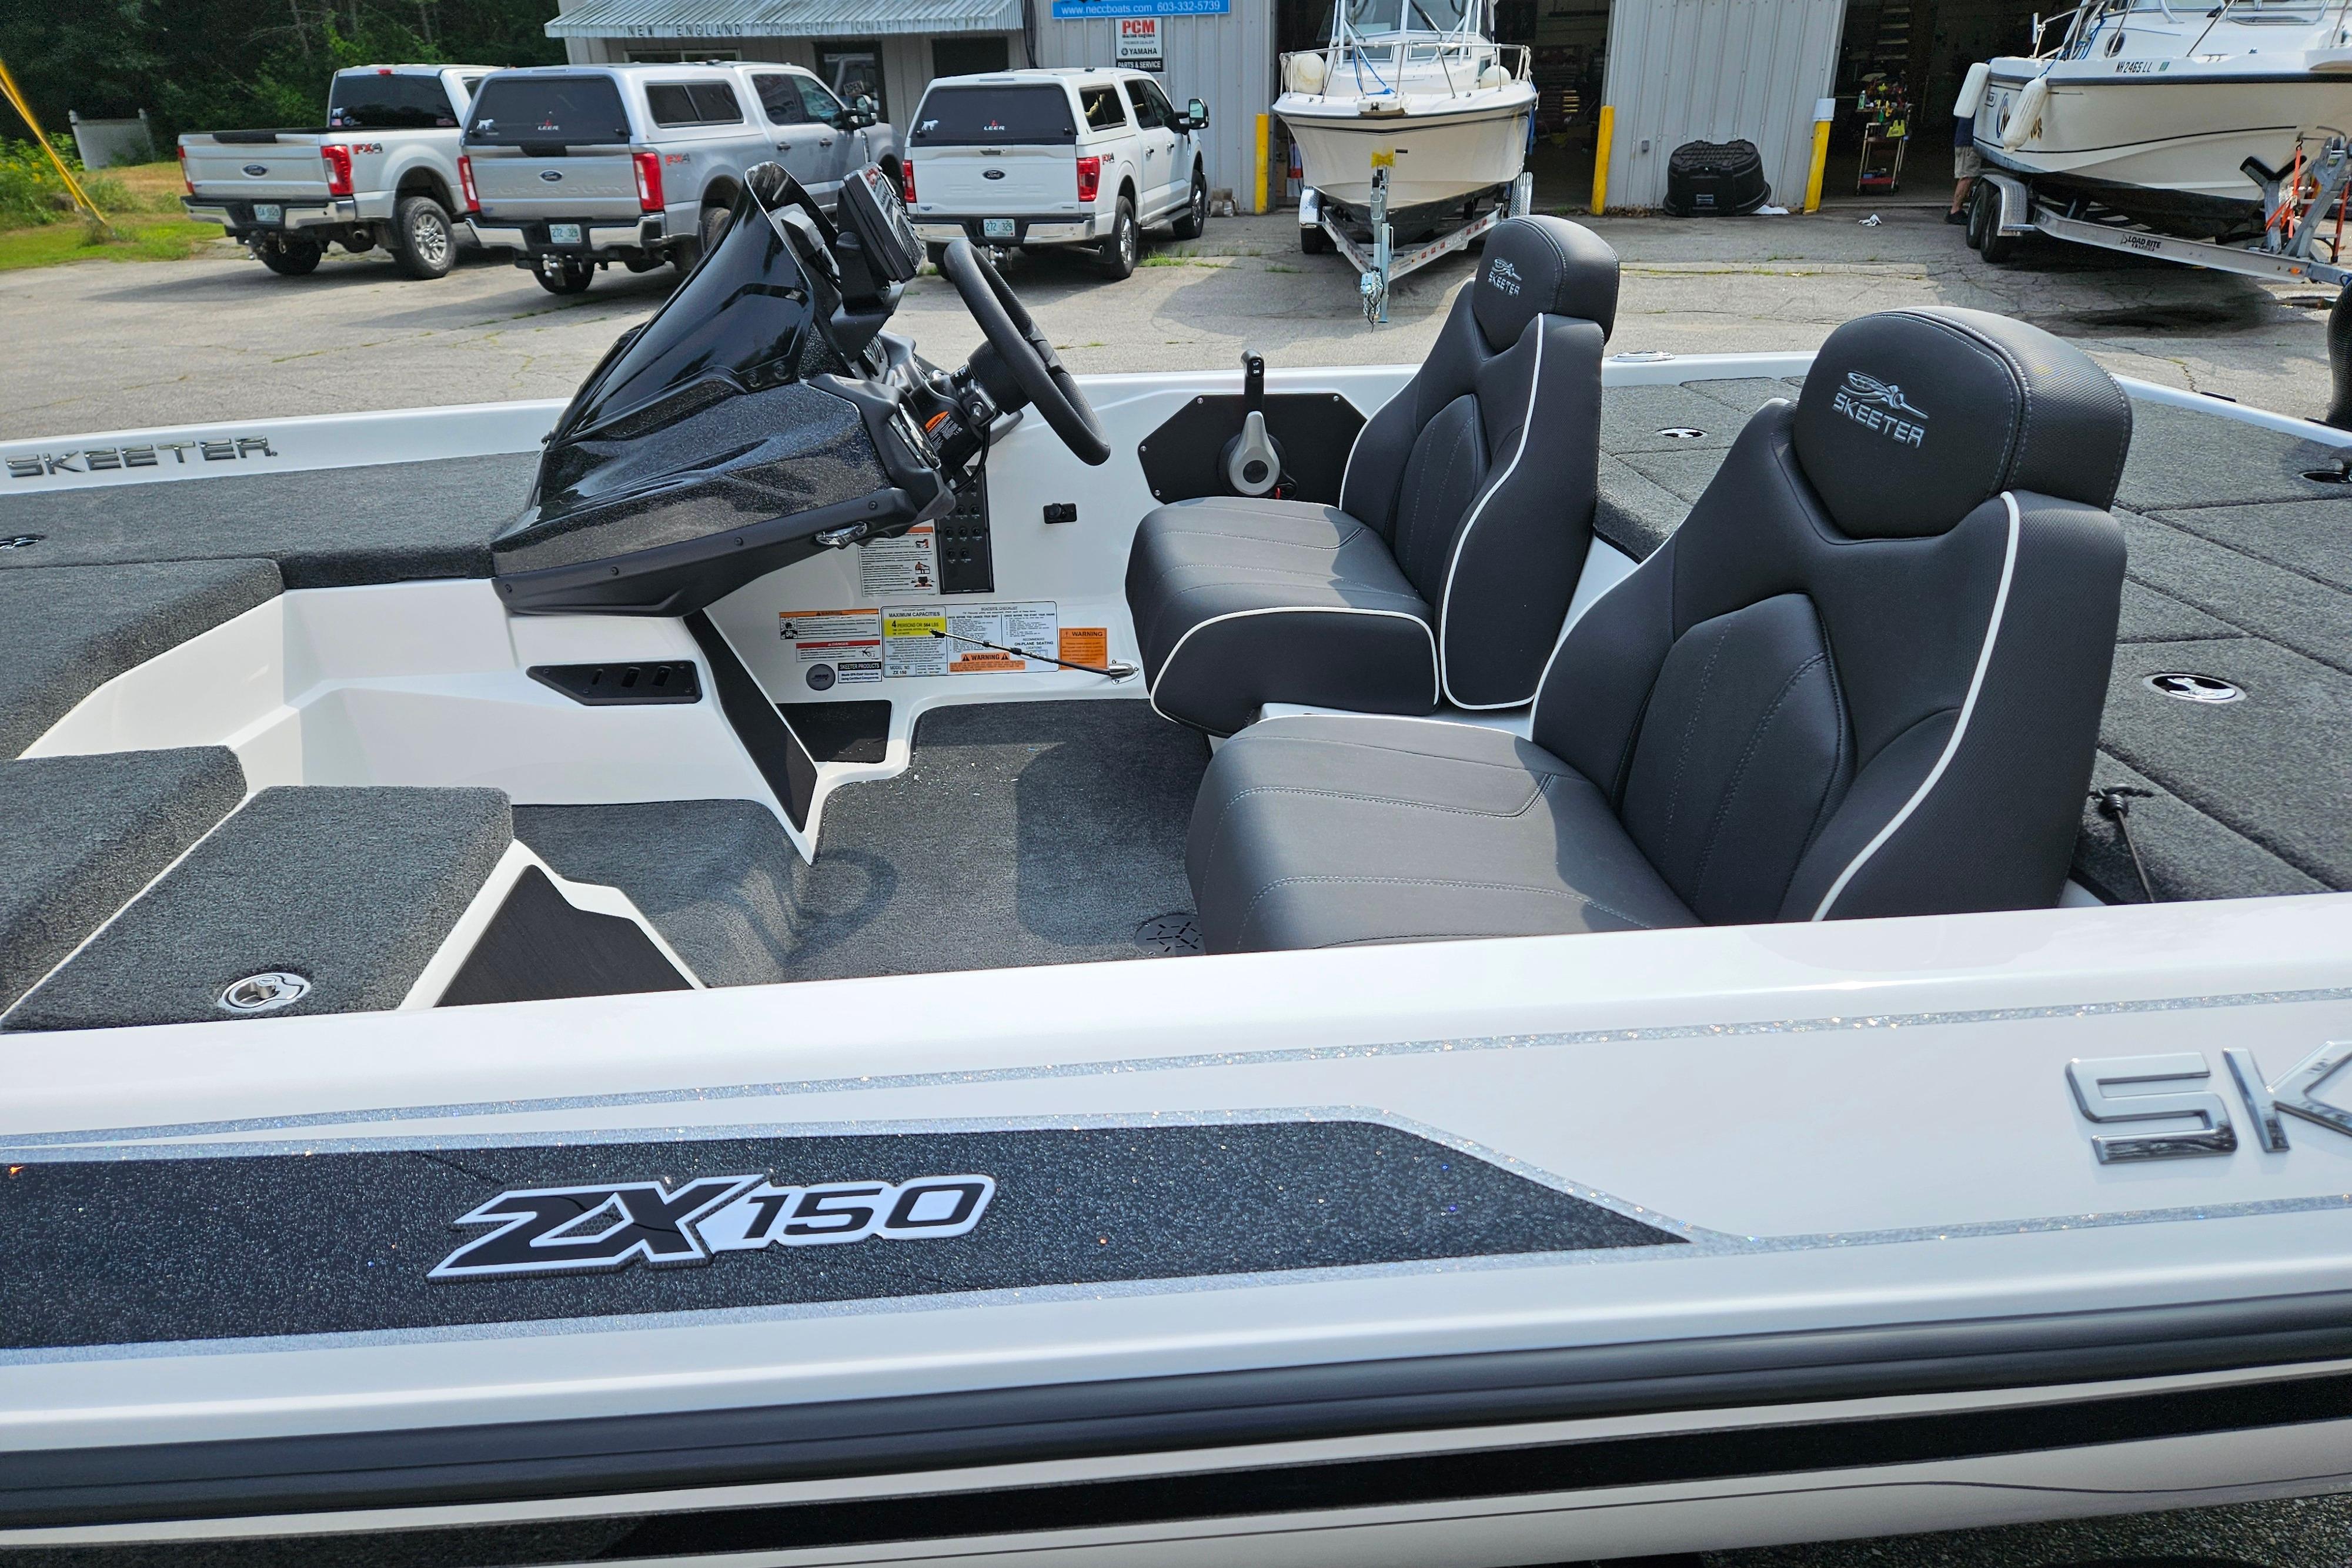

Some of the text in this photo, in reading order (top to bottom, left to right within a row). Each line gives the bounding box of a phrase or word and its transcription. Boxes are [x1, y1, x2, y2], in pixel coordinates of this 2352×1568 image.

[1061, 1, 1220, 15] www.neccboats.com 603-332-5739
[627, 25, 653, 36] NEW
[677, 24, 741, 36] ENGLAND
[1122, 19, 1155, 34] PCM
[2116, 61, 2153, 73] NH 2465 LL
[352, 143, 383, 155] FX4
[986, 222, 1013, 231] 272 329
[2128, 236, 2161, 248] LOAD RITE
[1488, 270, 1521, 298] SKEETER
[1832, 392, 1925, 449] SKEETER
[5, 435, 272, 478] SKEETER
[2064, 1039, 2352, 1165] SK
